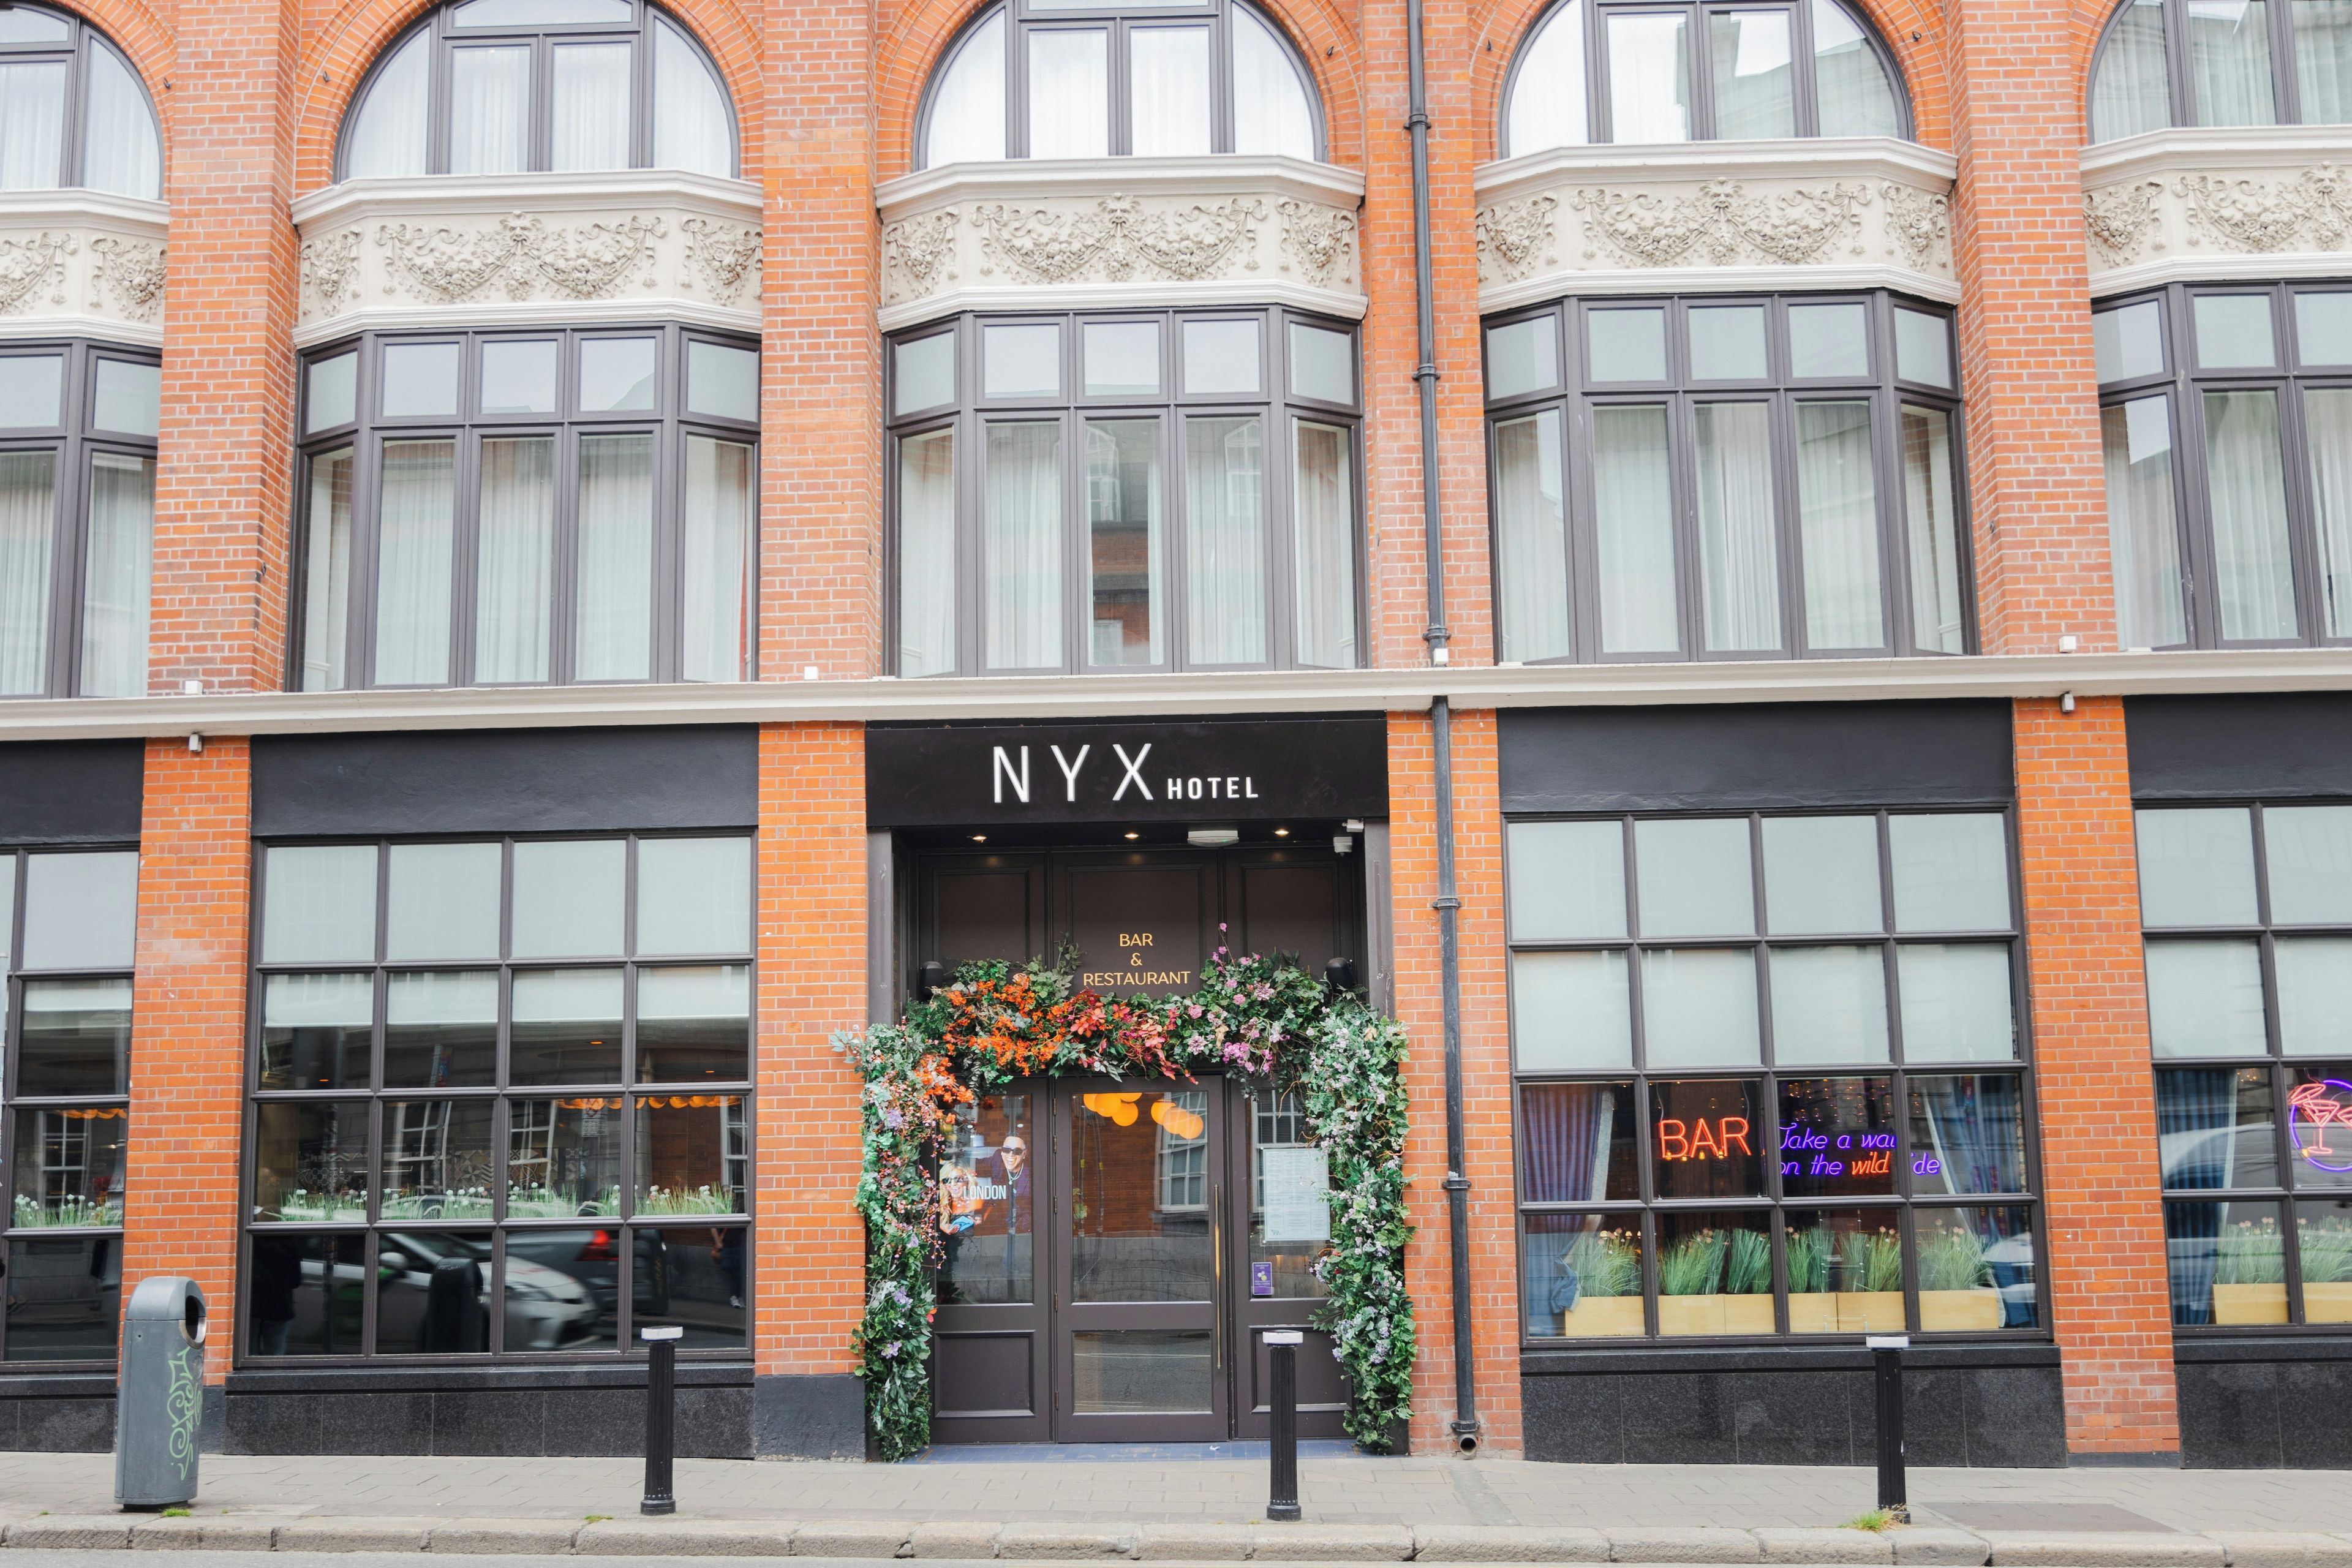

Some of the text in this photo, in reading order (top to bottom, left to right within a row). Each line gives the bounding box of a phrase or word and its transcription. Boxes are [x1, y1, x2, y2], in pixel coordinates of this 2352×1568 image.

[993, 743, 1259, 803] NYX HOTEL
[1119, 933, 1153, 947] BAR
[1130, 952, 1143, 967] &
[1083, 971, 1191, 986] RESTAURANT
[1659, 1117, 1752, 1158] BAR
[1779, 1122, 1828, 1149] Take
[1837, 1134, 1851, 1149] a
[1810, 1153, 1844, 1175] the
[1851, 1150, 1891, 1175] wild
[963, 1185, 1006, 1200] LONDON
